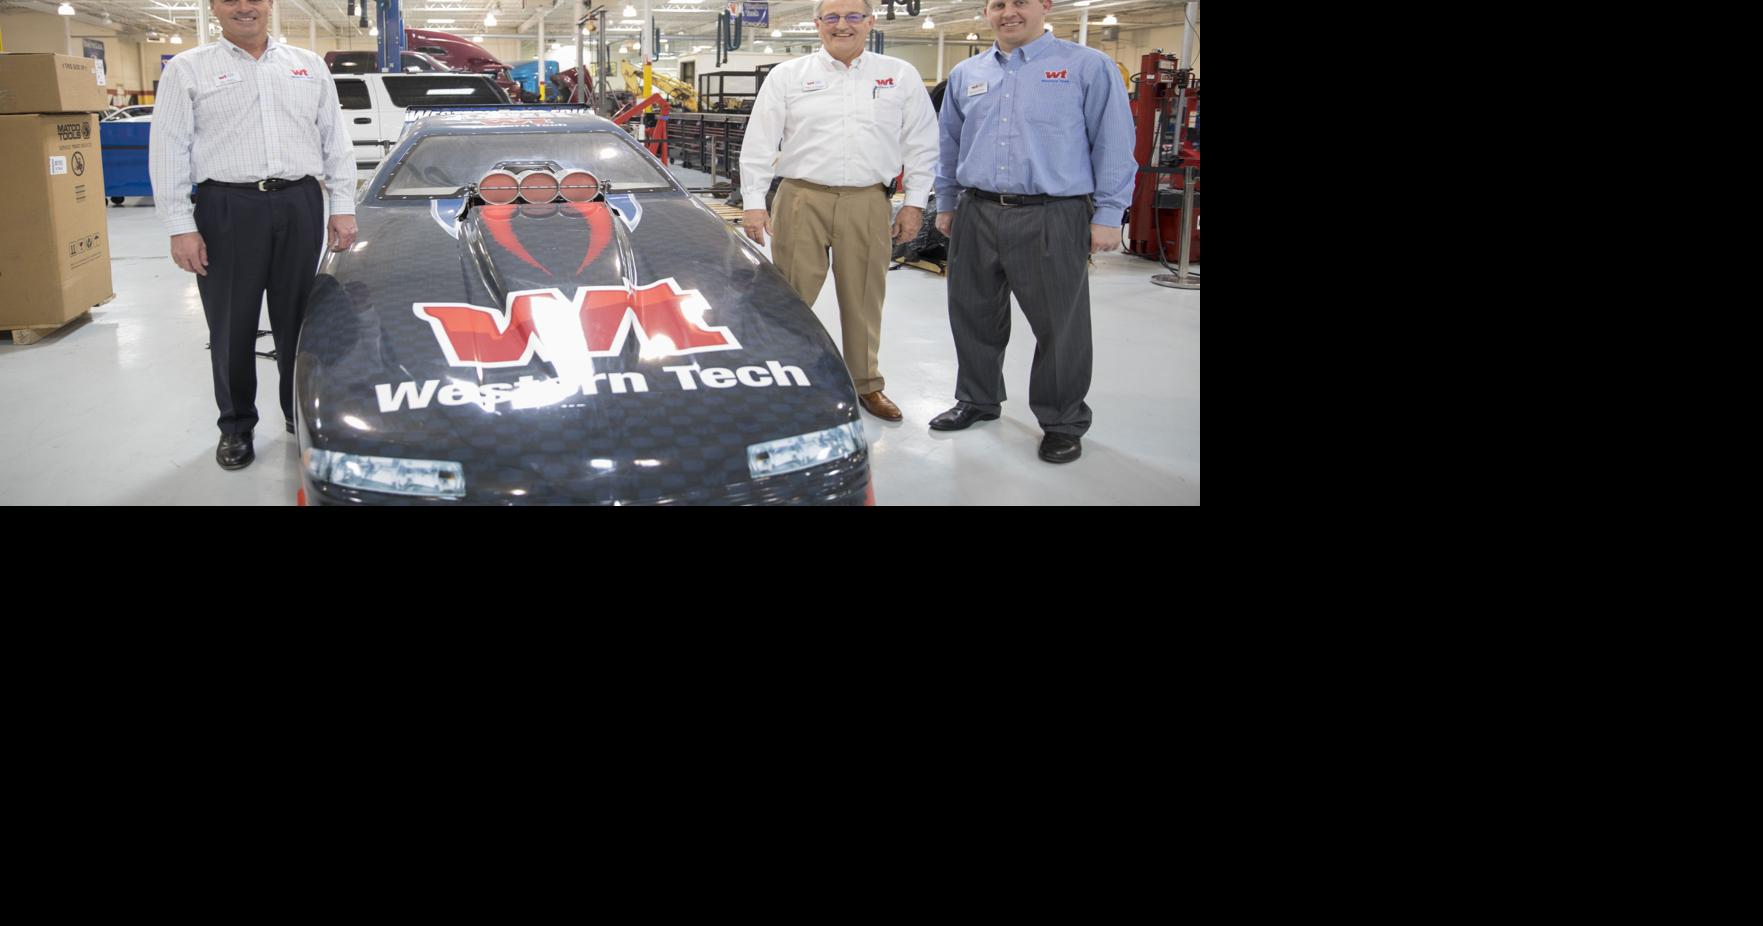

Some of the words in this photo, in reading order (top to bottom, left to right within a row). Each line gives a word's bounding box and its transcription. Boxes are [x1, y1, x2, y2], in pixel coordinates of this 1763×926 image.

[1045, 68, 1068, 79] wt
[57, 124, 81, 132] MATCO
[58, 132, 81, 140] TOOLS
[374, 369, 650, 413] Westrn
[662, 360, 811, 391] Tech
